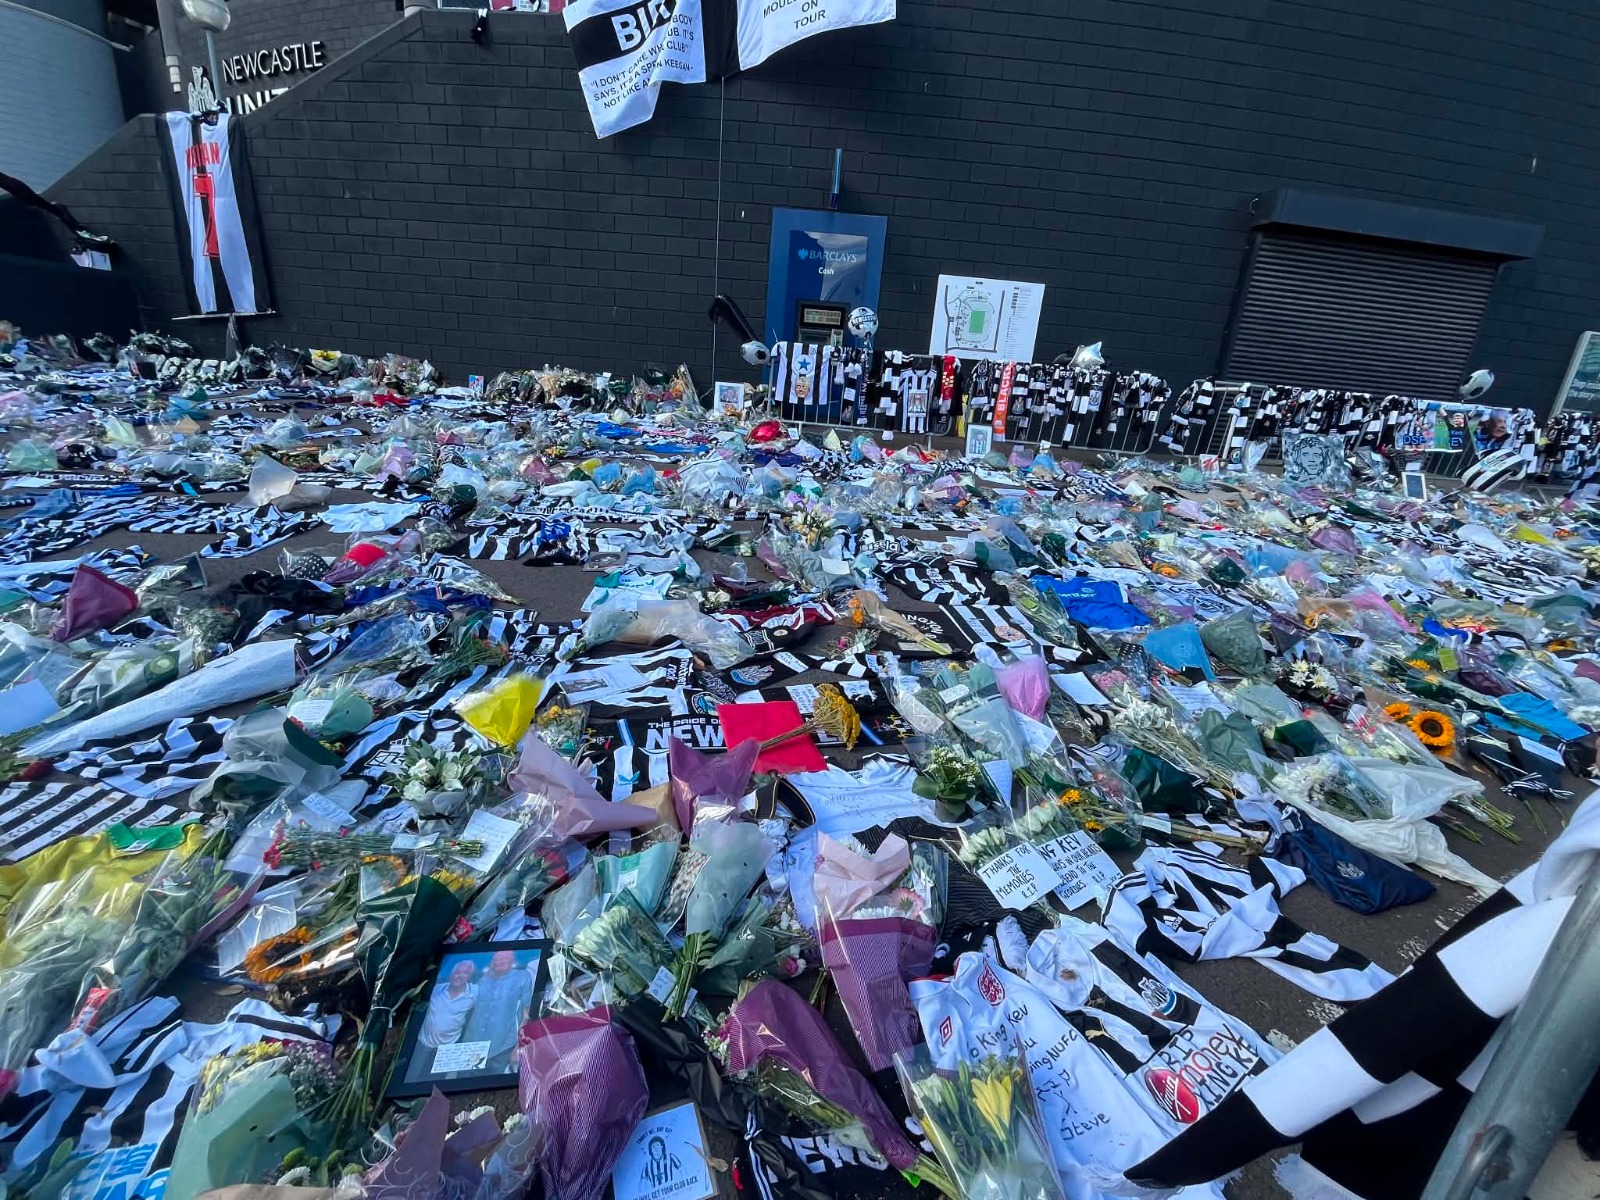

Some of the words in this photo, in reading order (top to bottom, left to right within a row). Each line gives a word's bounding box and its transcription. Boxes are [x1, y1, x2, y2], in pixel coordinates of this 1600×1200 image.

[802, 0, 819, 12] ON
[794, 10, 826, 29] TOUR
[222, 41, 323, 82] NEWCASTLE
[600, 71, 627, 87] DON'T
[628, 52, 648, 74] CARE
[634, 70, 641, 79] A
[603, 96, 621, 109] NOT
[622, 83, 641, 99] LIKE
[809, 250, 857, 263] BARCLAYS
[818, 267, 834, 275] Cash
[647, 721, 671, 729] THE
[673, 717, 706, 727] PRIDE
[1055, 834, 1082, 854] KEV
[982, 853, 1014, 879] THANKS
[1014, 844, 1031, 858] FOR
[1006, 863, 1022, 877] THE
[995, 869, 1035, 899] MEMORIES
[975, 1024, 1009, 1051] King
[1004, 1004, 1029, 1028] Kev
[1049, 1028, 1079, 1062] NUFC
[1158, 1029, 1197, 1073] RIP
[1178, 1023, 1245, 1090] money
[1060, 1112, 1111, 1141] Steve
[661, 1184, 674, 1196] YOUR
[673, 1179, 686, 1190] CLUB
[686, 1175, 699, 1186] BACK
